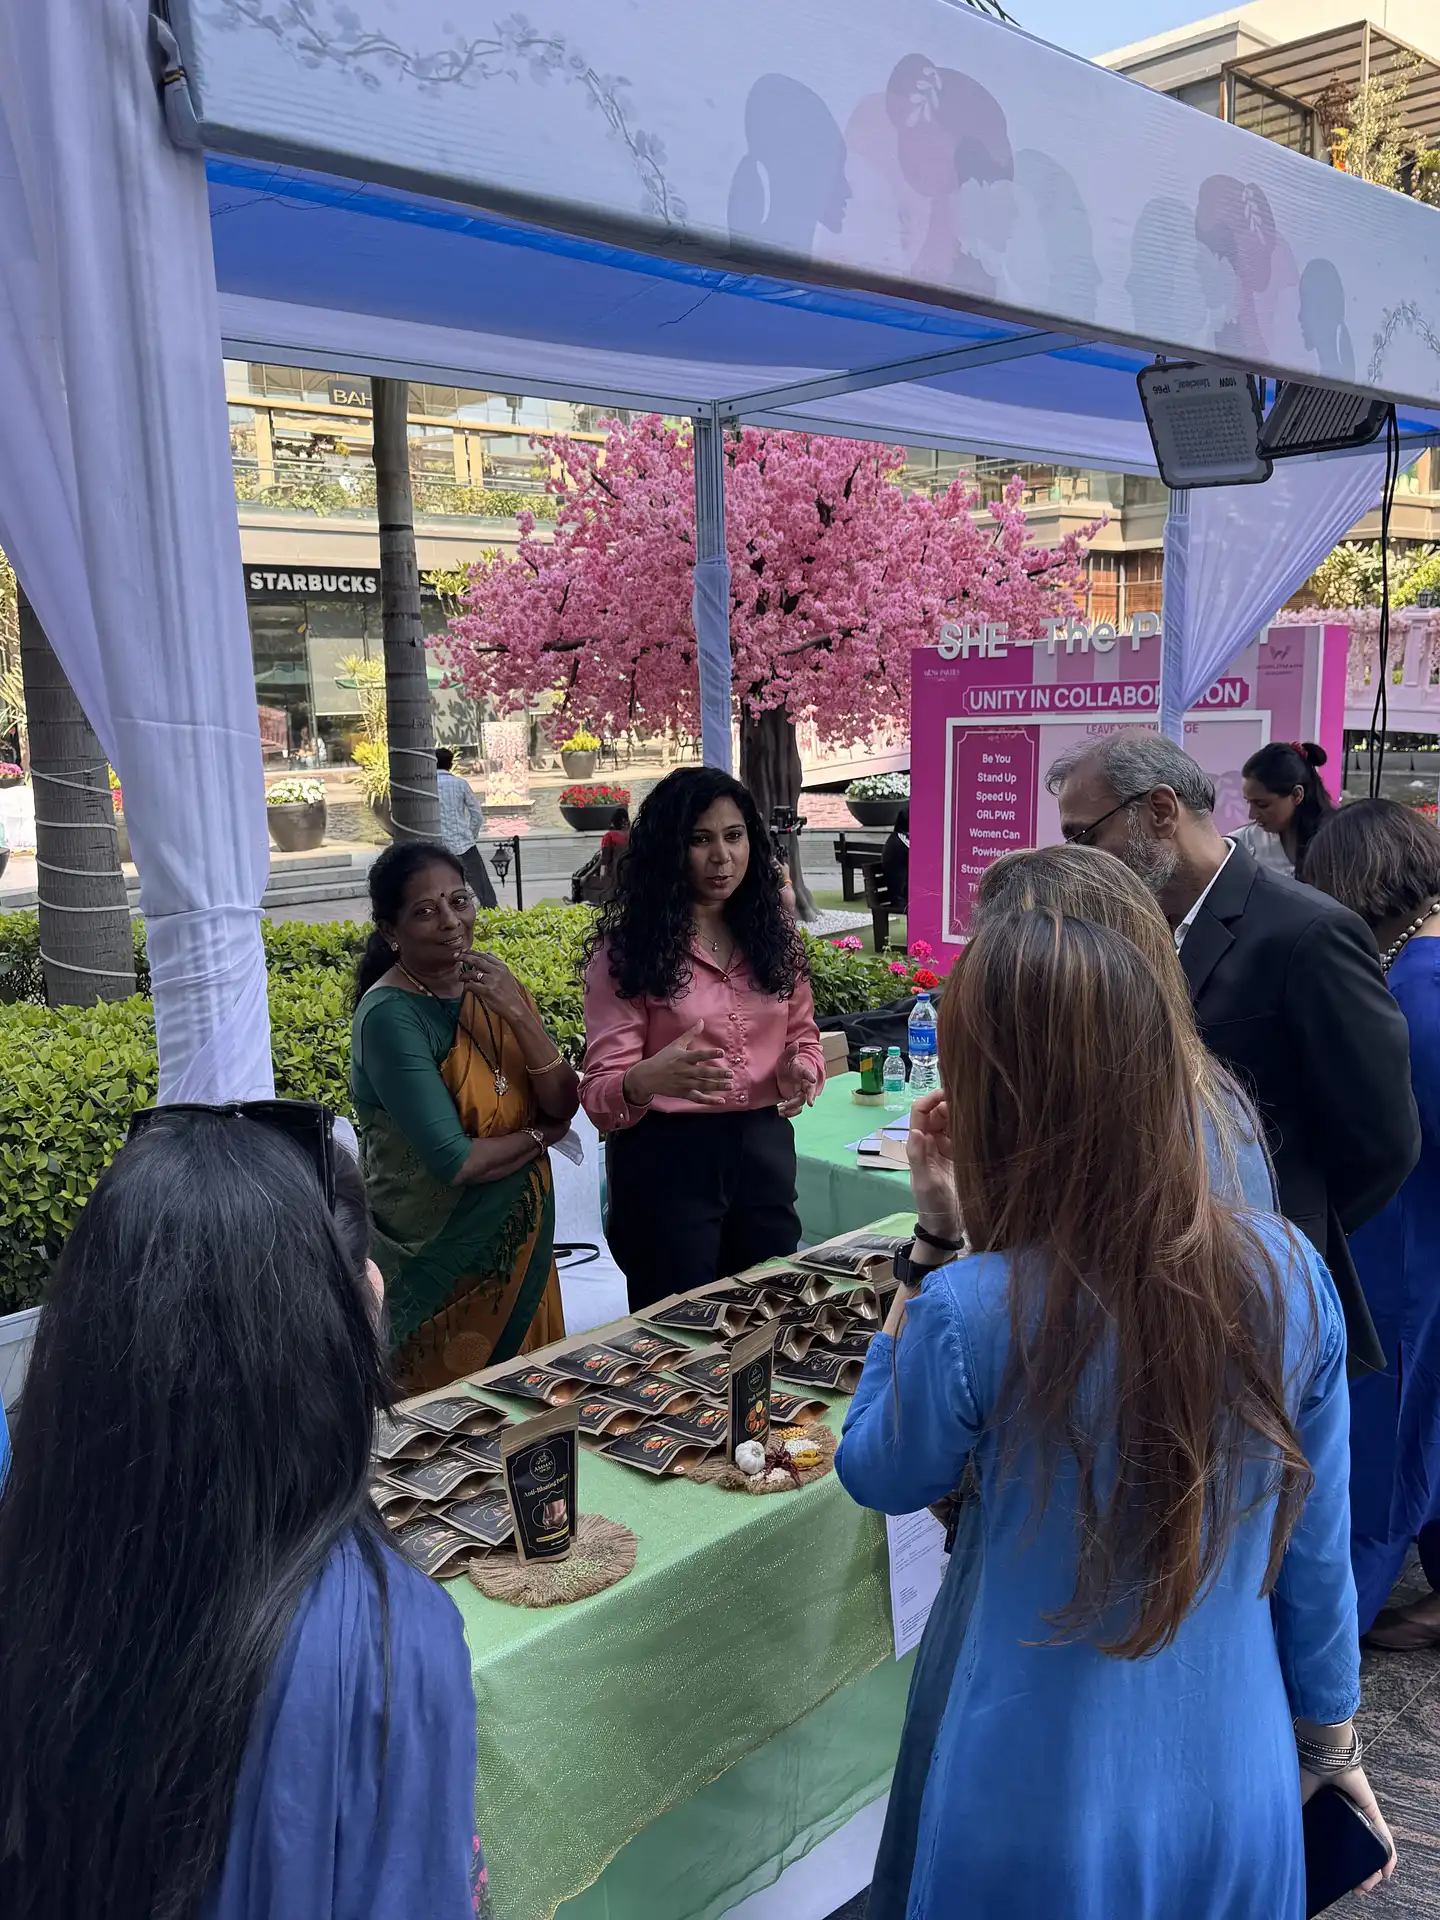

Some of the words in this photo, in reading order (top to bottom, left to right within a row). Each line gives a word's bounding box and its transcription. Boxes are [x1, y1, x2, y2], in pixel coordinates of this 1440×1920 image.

[1152, 383, 1171, 395] IP66
[249, 572, 377, 594] STARBUCKS
[937, 621, 1008, 660] SHE
[1040, 616, 1117, 655] The
[969, 689, 1027, 711] UNITY
[1030, 688, 1050, 709] IN
[982, 753, 994, 764] Be
[994, 753, 1011, 764] You
[977, 772, 1003, 783] Stand
[1004, 773, 1017, 785] Up
[976, 791, 1003, 803] Speed
[1004, 791, 1017, 803] Up
[994, 810, 1016, 821] PWR
[969, 828, 1001, 838] Women
[1002, 829, 1020, 840] Can
